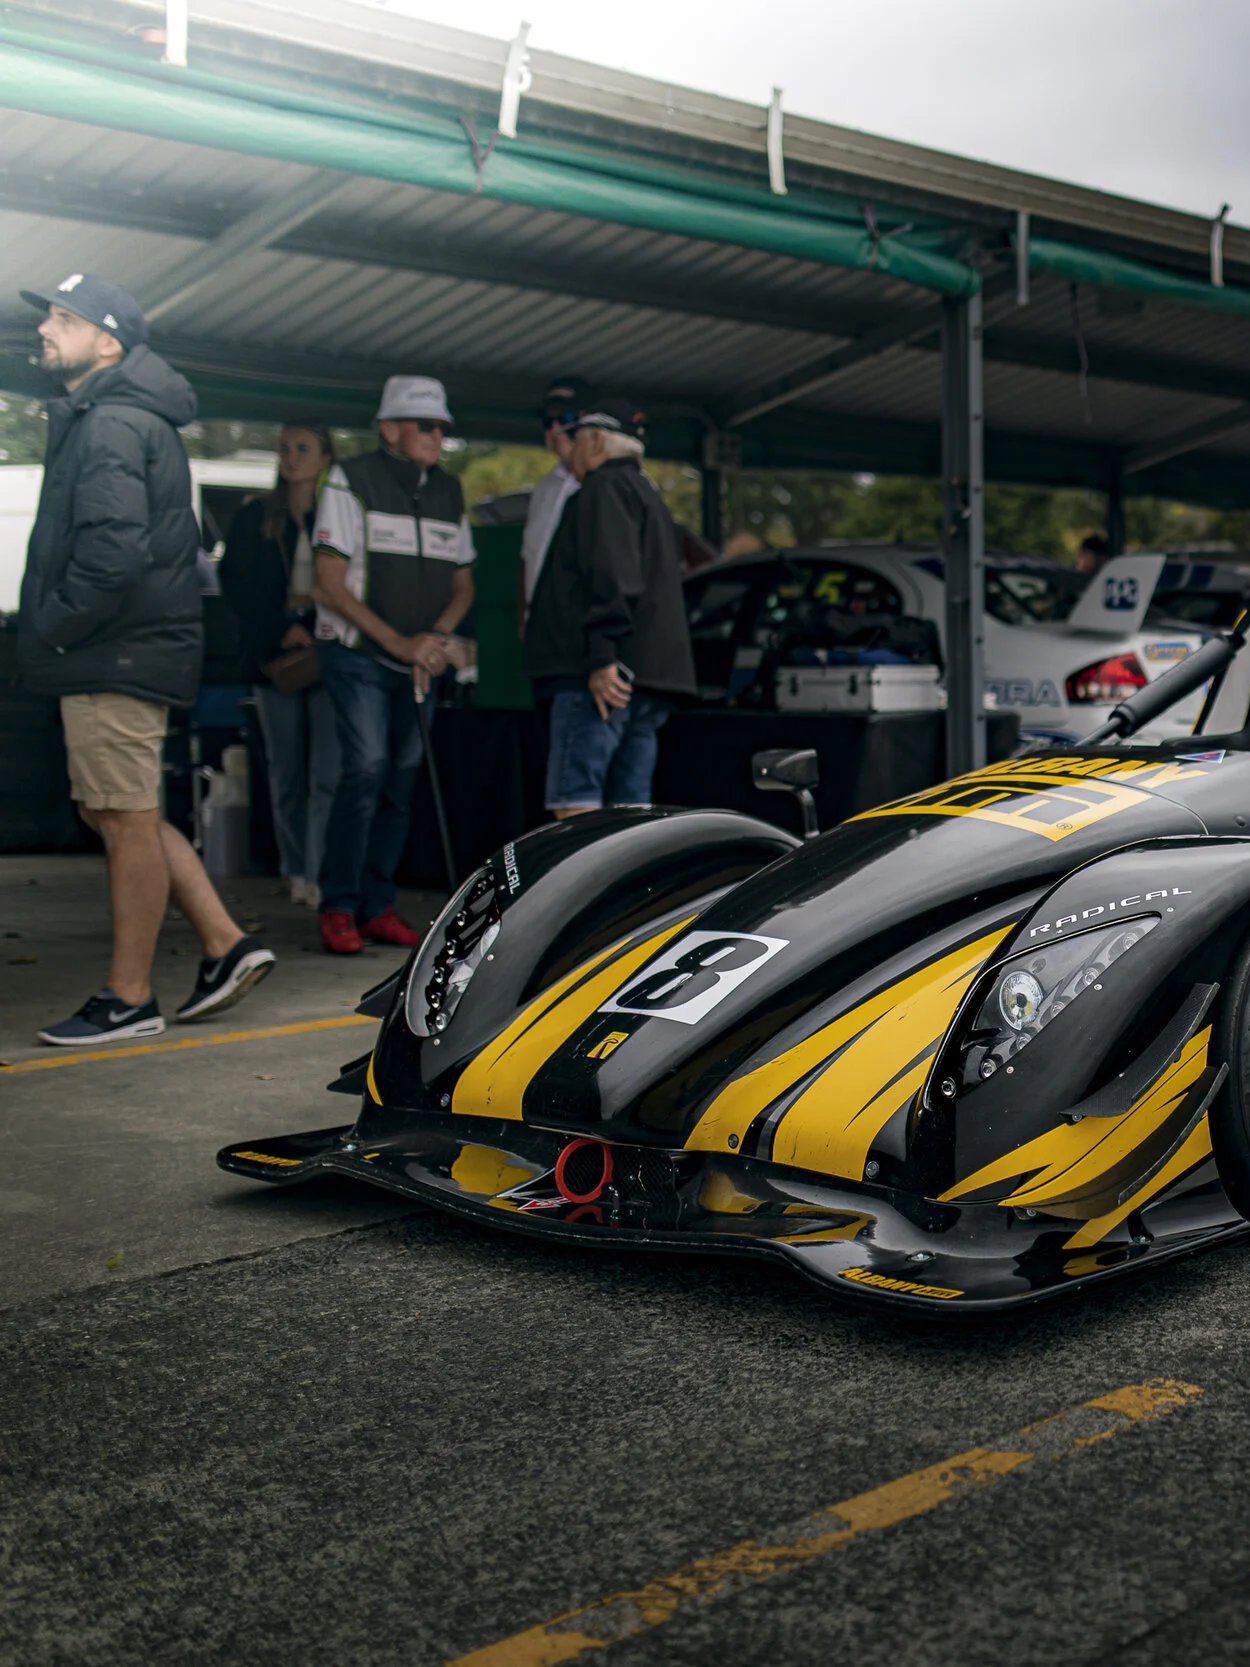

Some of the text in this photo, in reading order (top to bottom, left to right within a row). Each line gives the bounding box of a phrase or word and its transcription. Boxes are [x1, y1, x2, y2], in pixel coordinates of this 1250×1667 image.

[1029, 887, 1193, 938] RADICAL
[616, 938, 769, 1010] 8
[838, 1267, 925, 1292] ALBANY
